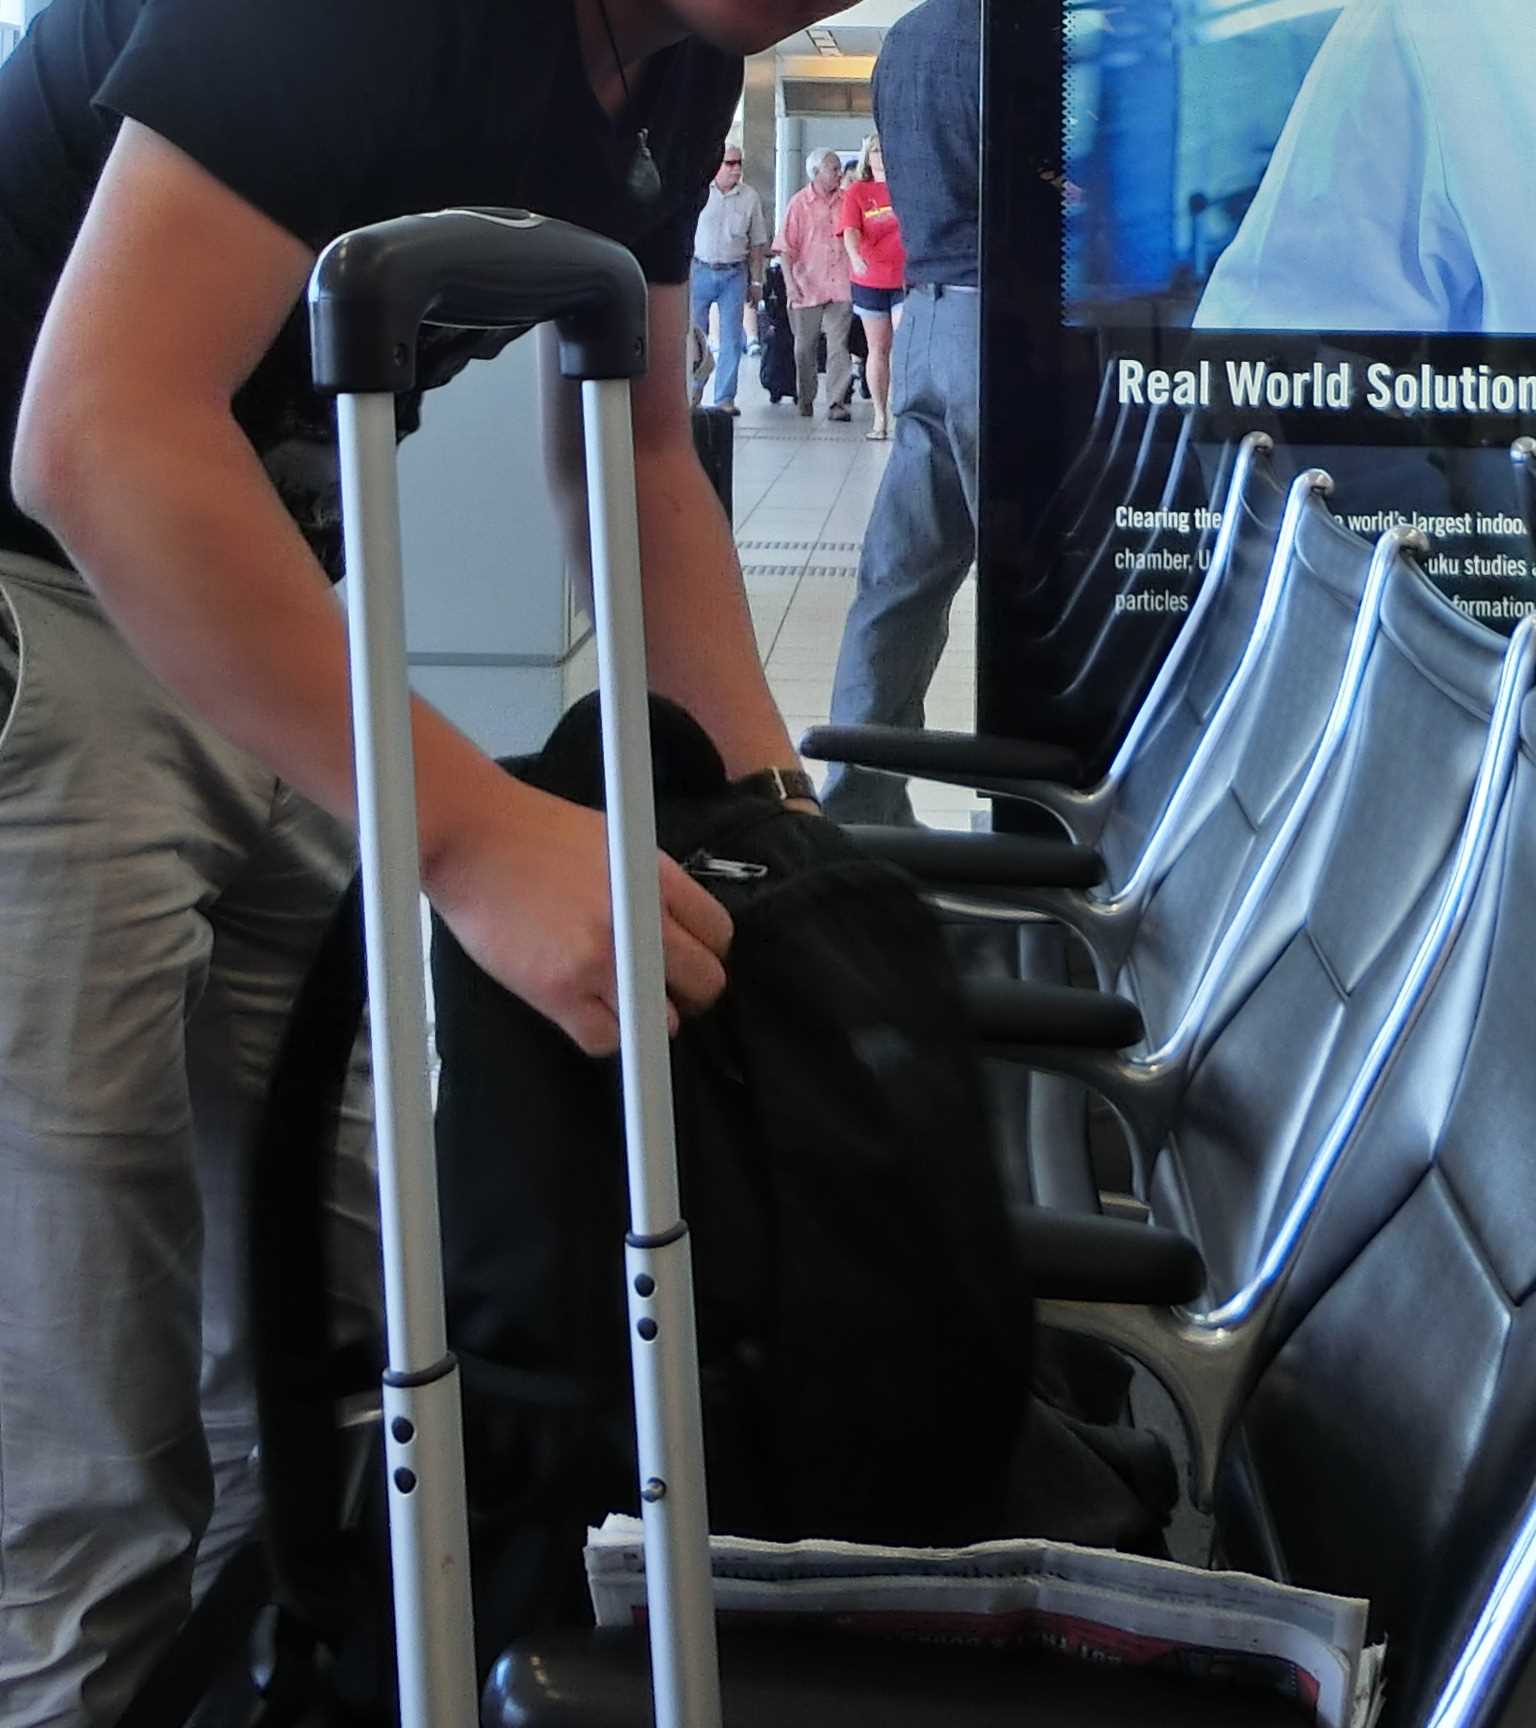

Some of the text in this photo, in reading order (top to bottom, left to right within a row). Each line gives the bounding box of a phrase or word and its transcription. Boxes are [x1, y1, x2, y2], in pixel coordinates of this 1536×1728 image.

[1118, 358, 1209, 405] Real
[1226, 360, 1351, 408] World
[1115, 506, 1190, 532] Clearing
[1194, 508, 1222, 529] the
[1412, 511, 1473, 536] largest
[1476, 514, 1527, 535] indoo
[1114, 547, 1193, 572] chamber,
[1425, 553, 1460, 575] uku
[1464, 554, 1526, 577] studies
[1115, 589, 1189, 614] particles
